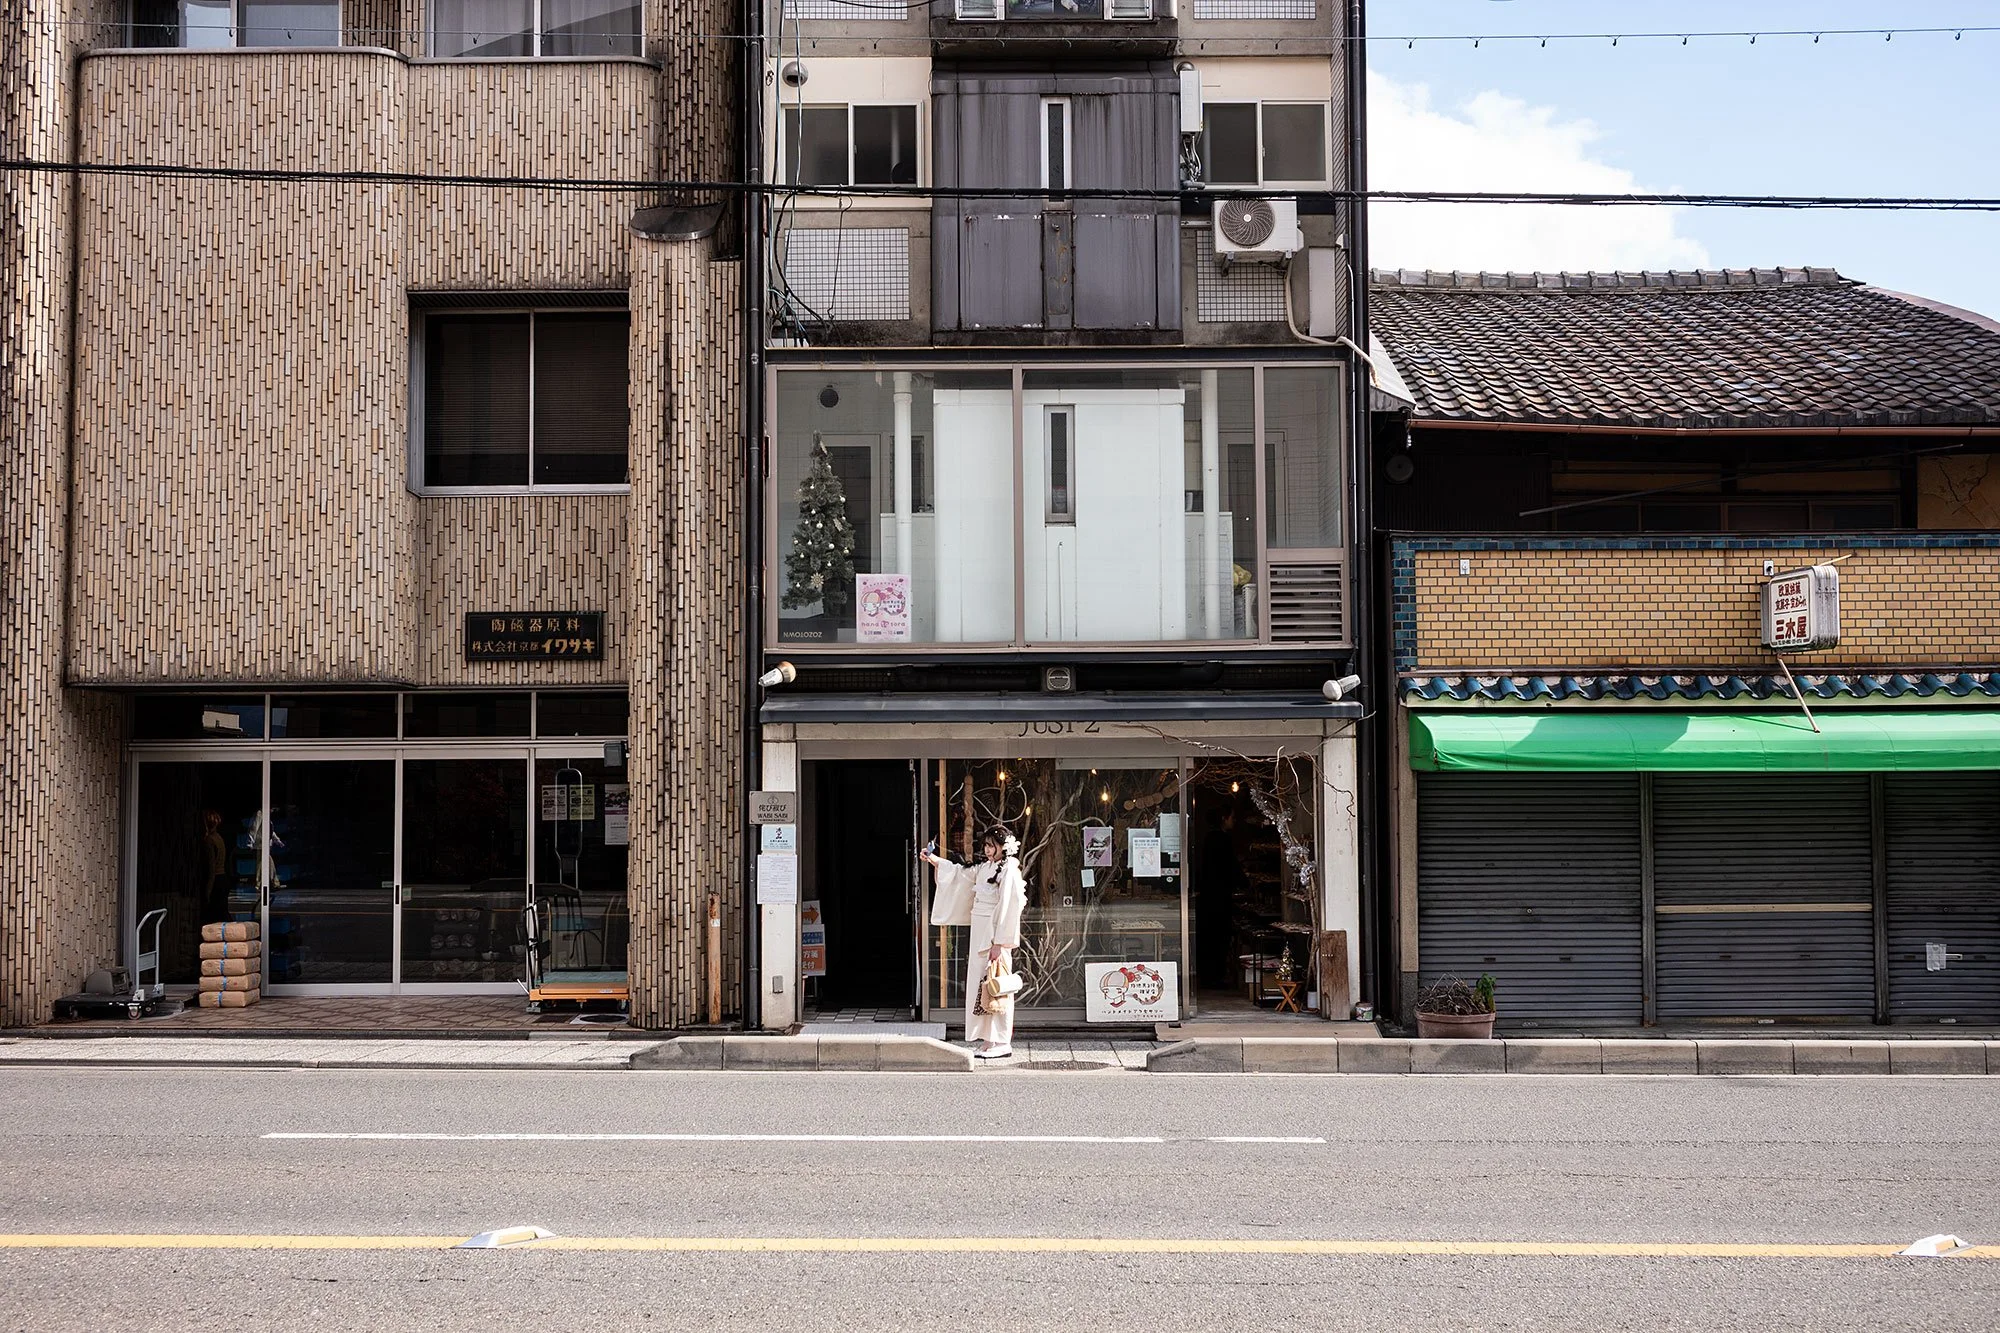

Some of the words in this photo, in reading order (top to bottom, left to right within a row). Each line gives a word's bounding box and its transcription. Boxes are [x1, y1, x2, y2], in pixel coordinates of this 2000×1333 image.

[491, 618, 580, 633] 陶磁器原料
[1775, 616, 1807, 640] 三木屋
